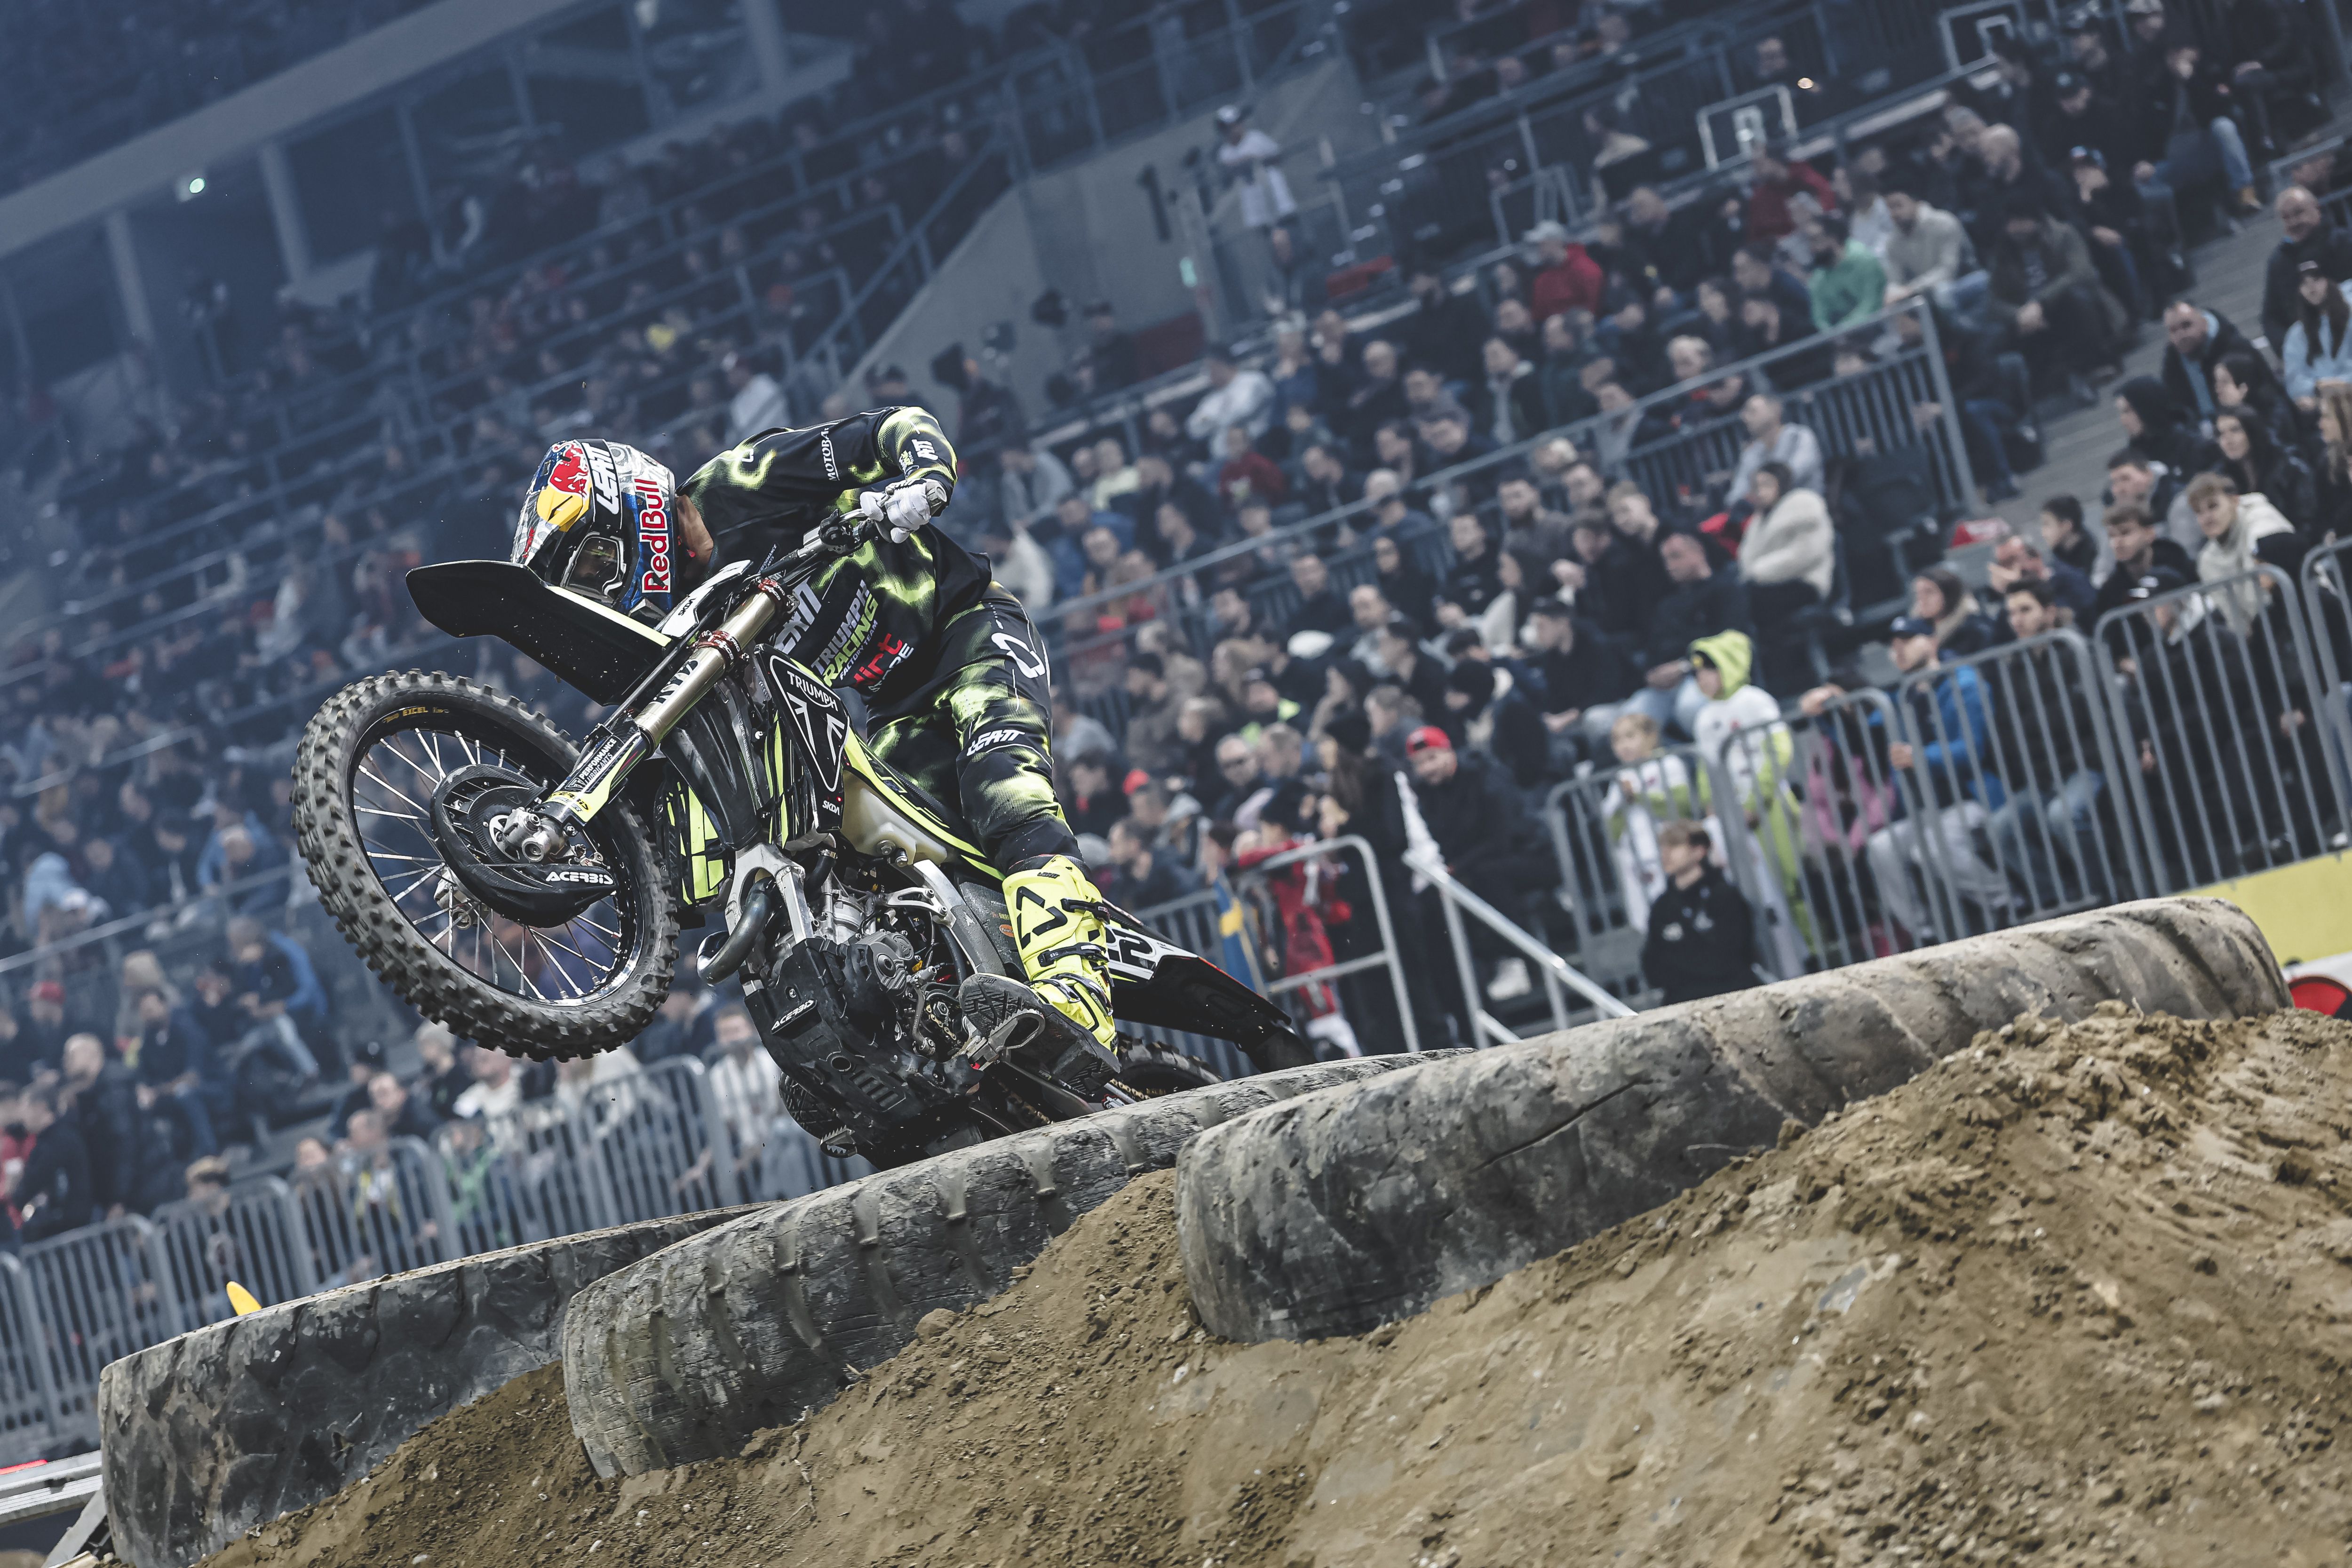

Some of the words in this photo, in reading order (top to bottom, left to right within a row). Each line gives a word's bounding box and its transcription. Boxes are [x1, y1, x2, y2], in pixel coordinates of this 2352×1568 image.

[581, 443, 620, 515] LEATT
[810, 579, 870, 676] TRIUMPH
[823, 593, 878, 687] RACING
[839, 645, 864, 681] FACTORY
[863, 619, 878, 646] TEAM
[787, 670, 838, 712] TRIUMPH
[578, 737, 618, 779] PERFORMANCE
[967, 729, 1025, 756] LEATT
[545, 871, 614, 885] ACERBIS
[771, 999, 815, 1031] ACERBIS
